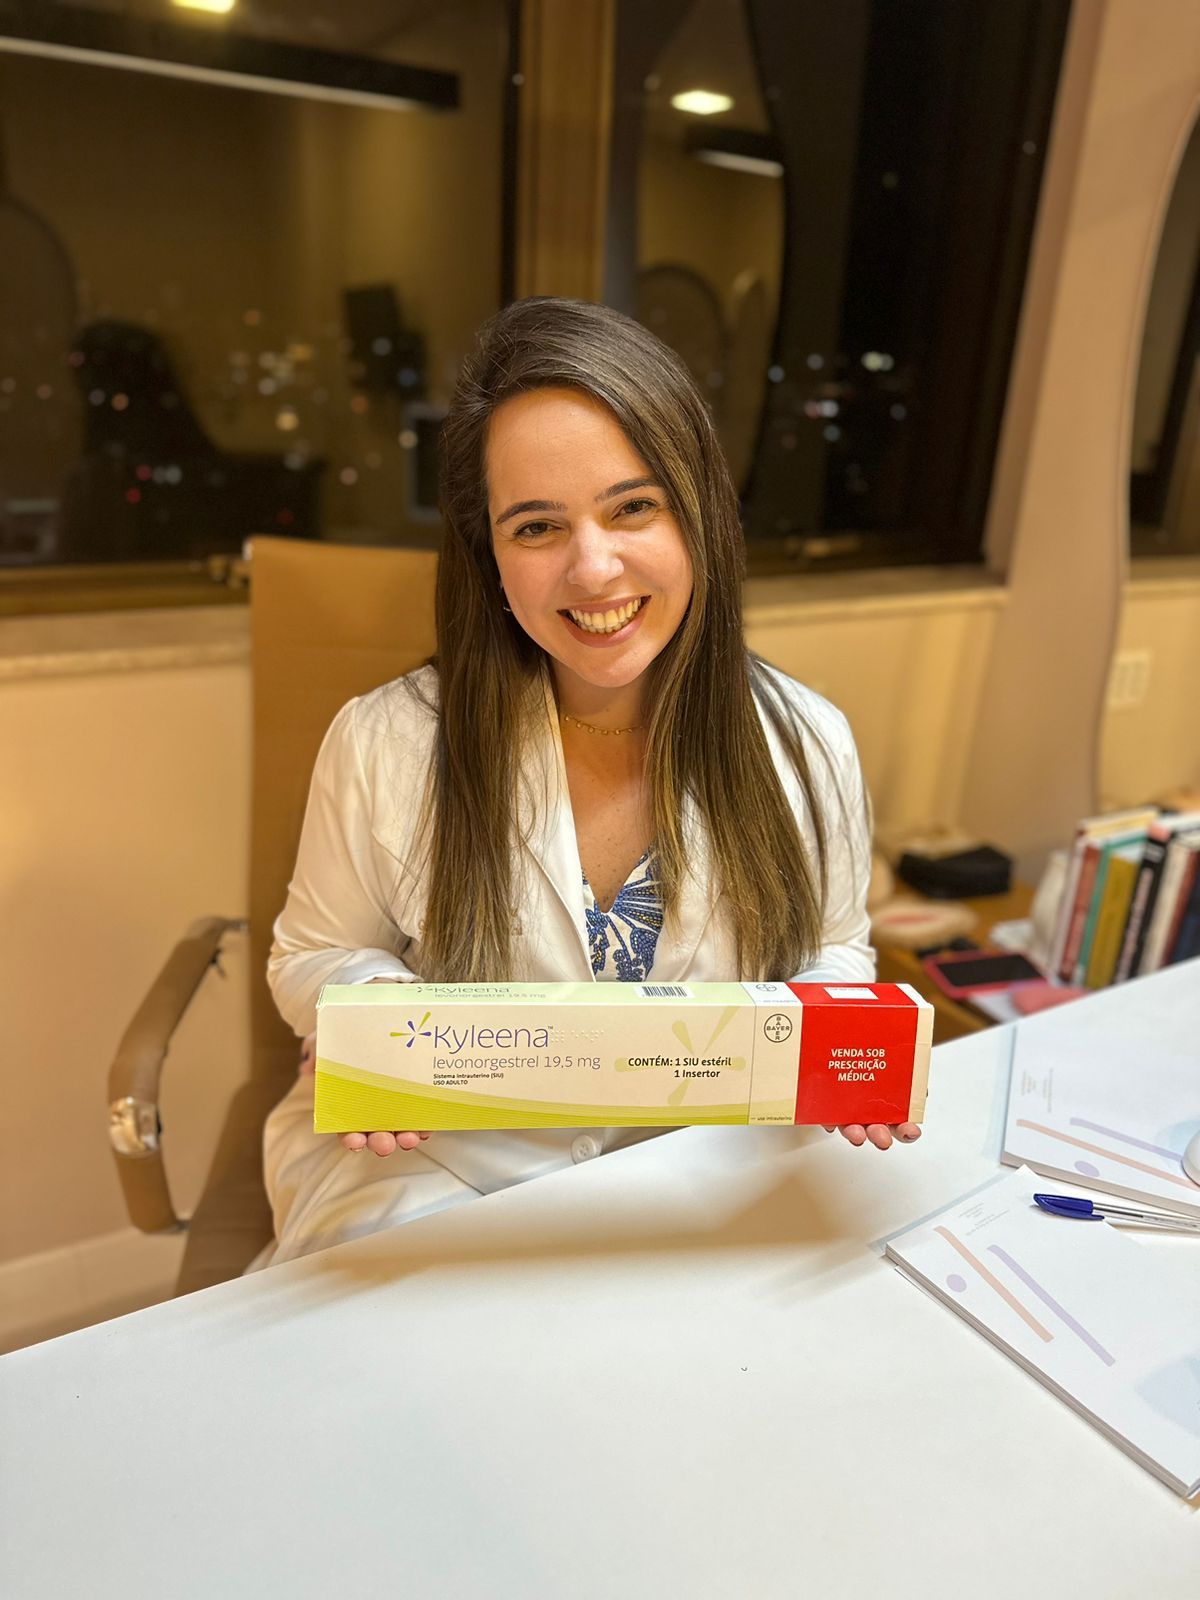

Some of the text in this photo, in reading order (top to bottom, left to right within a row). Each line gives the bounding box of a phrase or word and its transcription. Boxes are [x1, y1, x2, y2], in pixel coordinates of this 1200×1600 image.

[831, 1048, 886, 1058] VENDA SOB
[433, 1056, 601, 1071] levonorgestrel 19,5 mg
[628, 1055, 732, 1066] CONTÉM: 1 SIU estéril
[828, 1058, 887, 1071] PRESCRIÇÃO
[674, 1069, 721, 1078] 1 Insertor
[838, 1070, 876, 1082] MÉDICA
